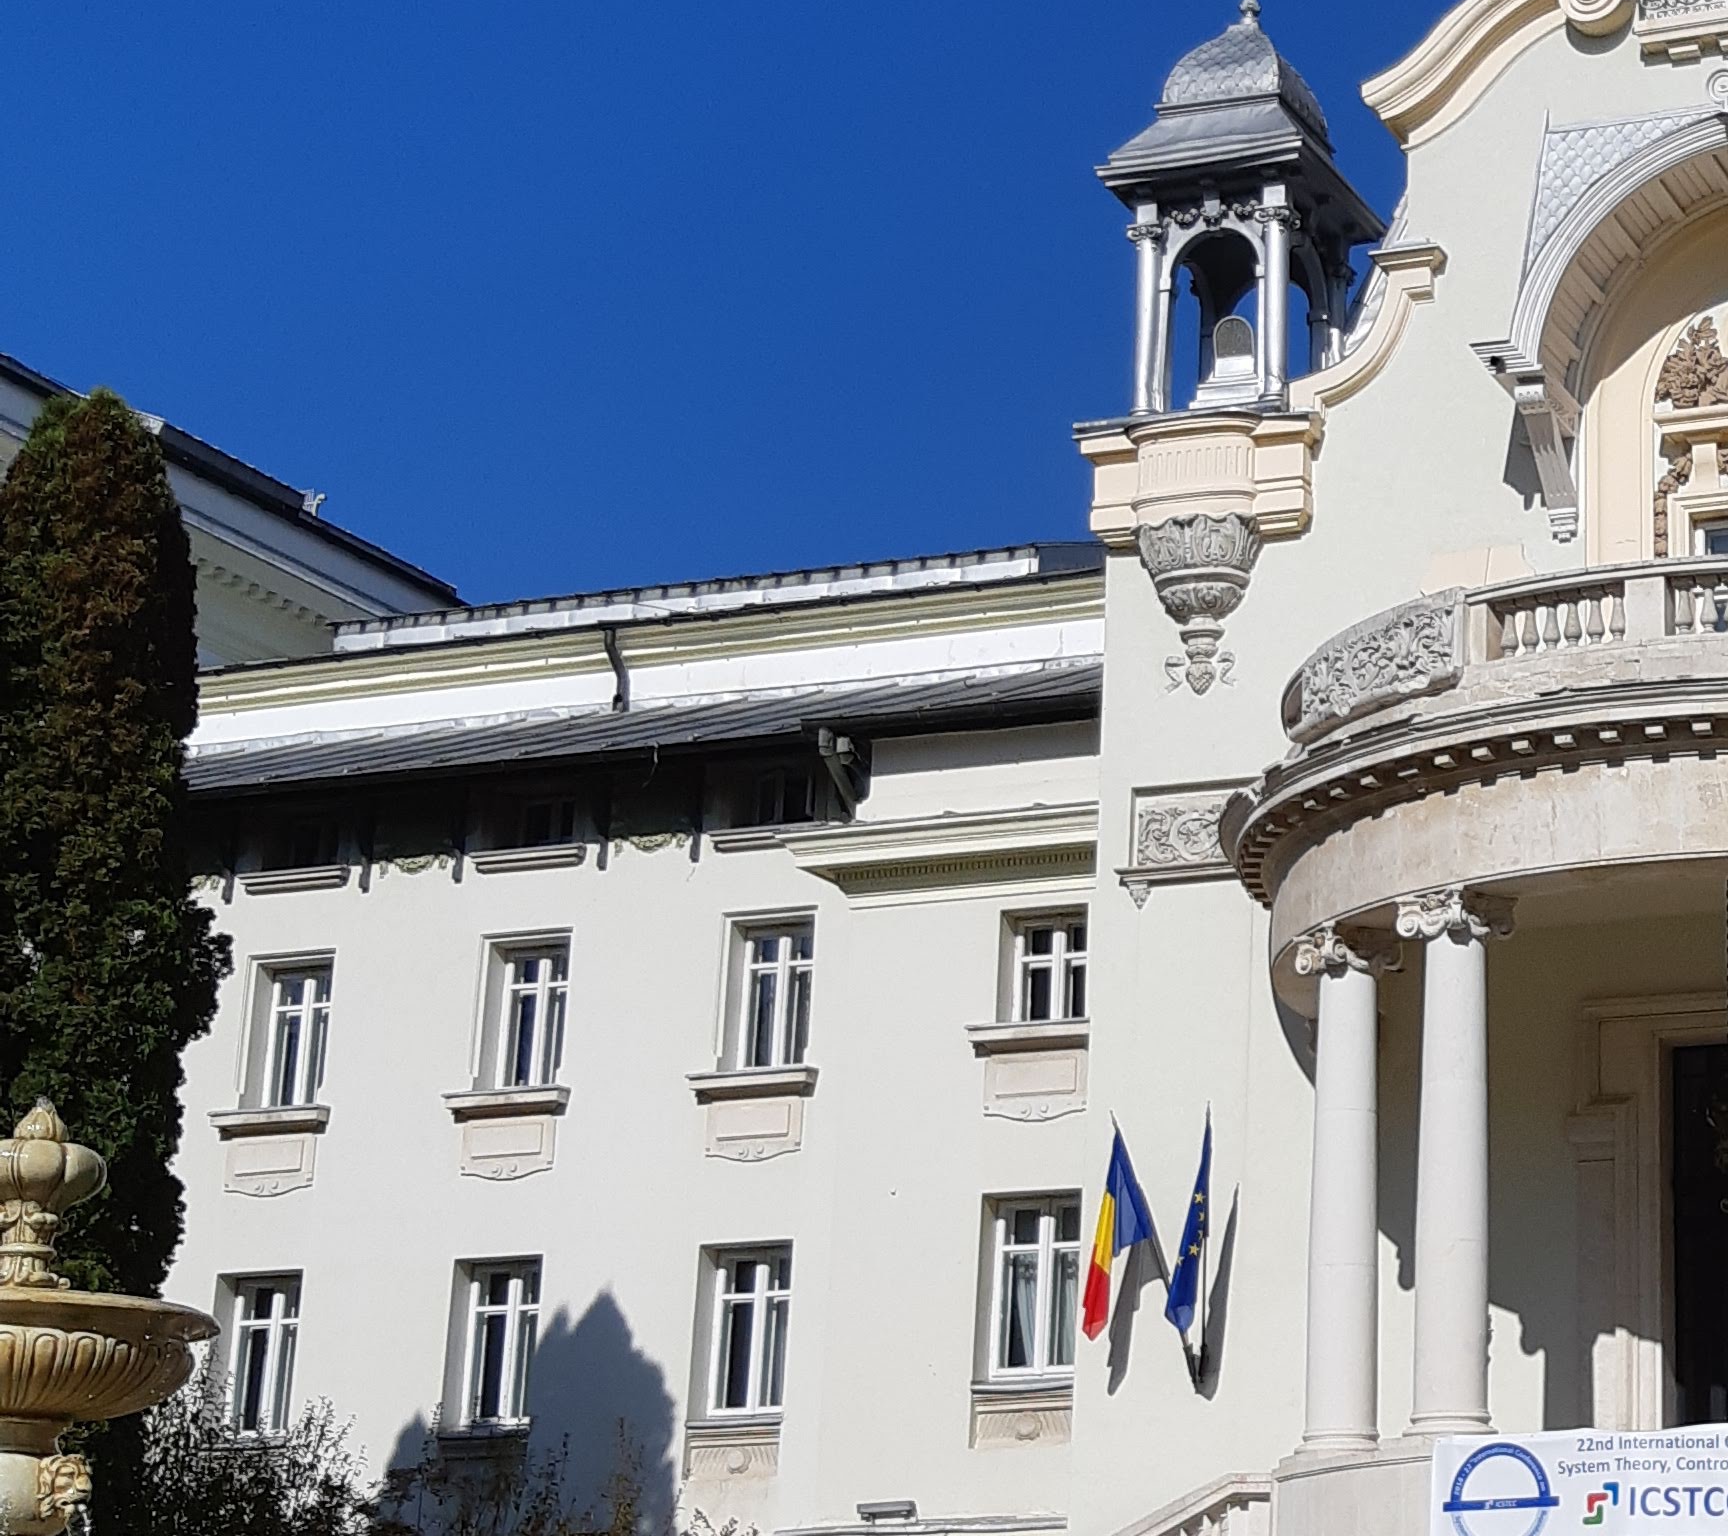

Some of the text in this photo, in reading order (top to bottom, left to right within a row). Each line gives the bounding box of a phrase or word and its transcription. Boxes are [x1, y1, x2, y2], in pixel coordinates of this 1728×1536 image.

[1576, 1436, 1614, 1452] 22nd
[1618, 1434, 1720, 1450] International
[1557, 1458, 1611, 1476] System
[1615, 1457, 1672, 1474] Theory,
